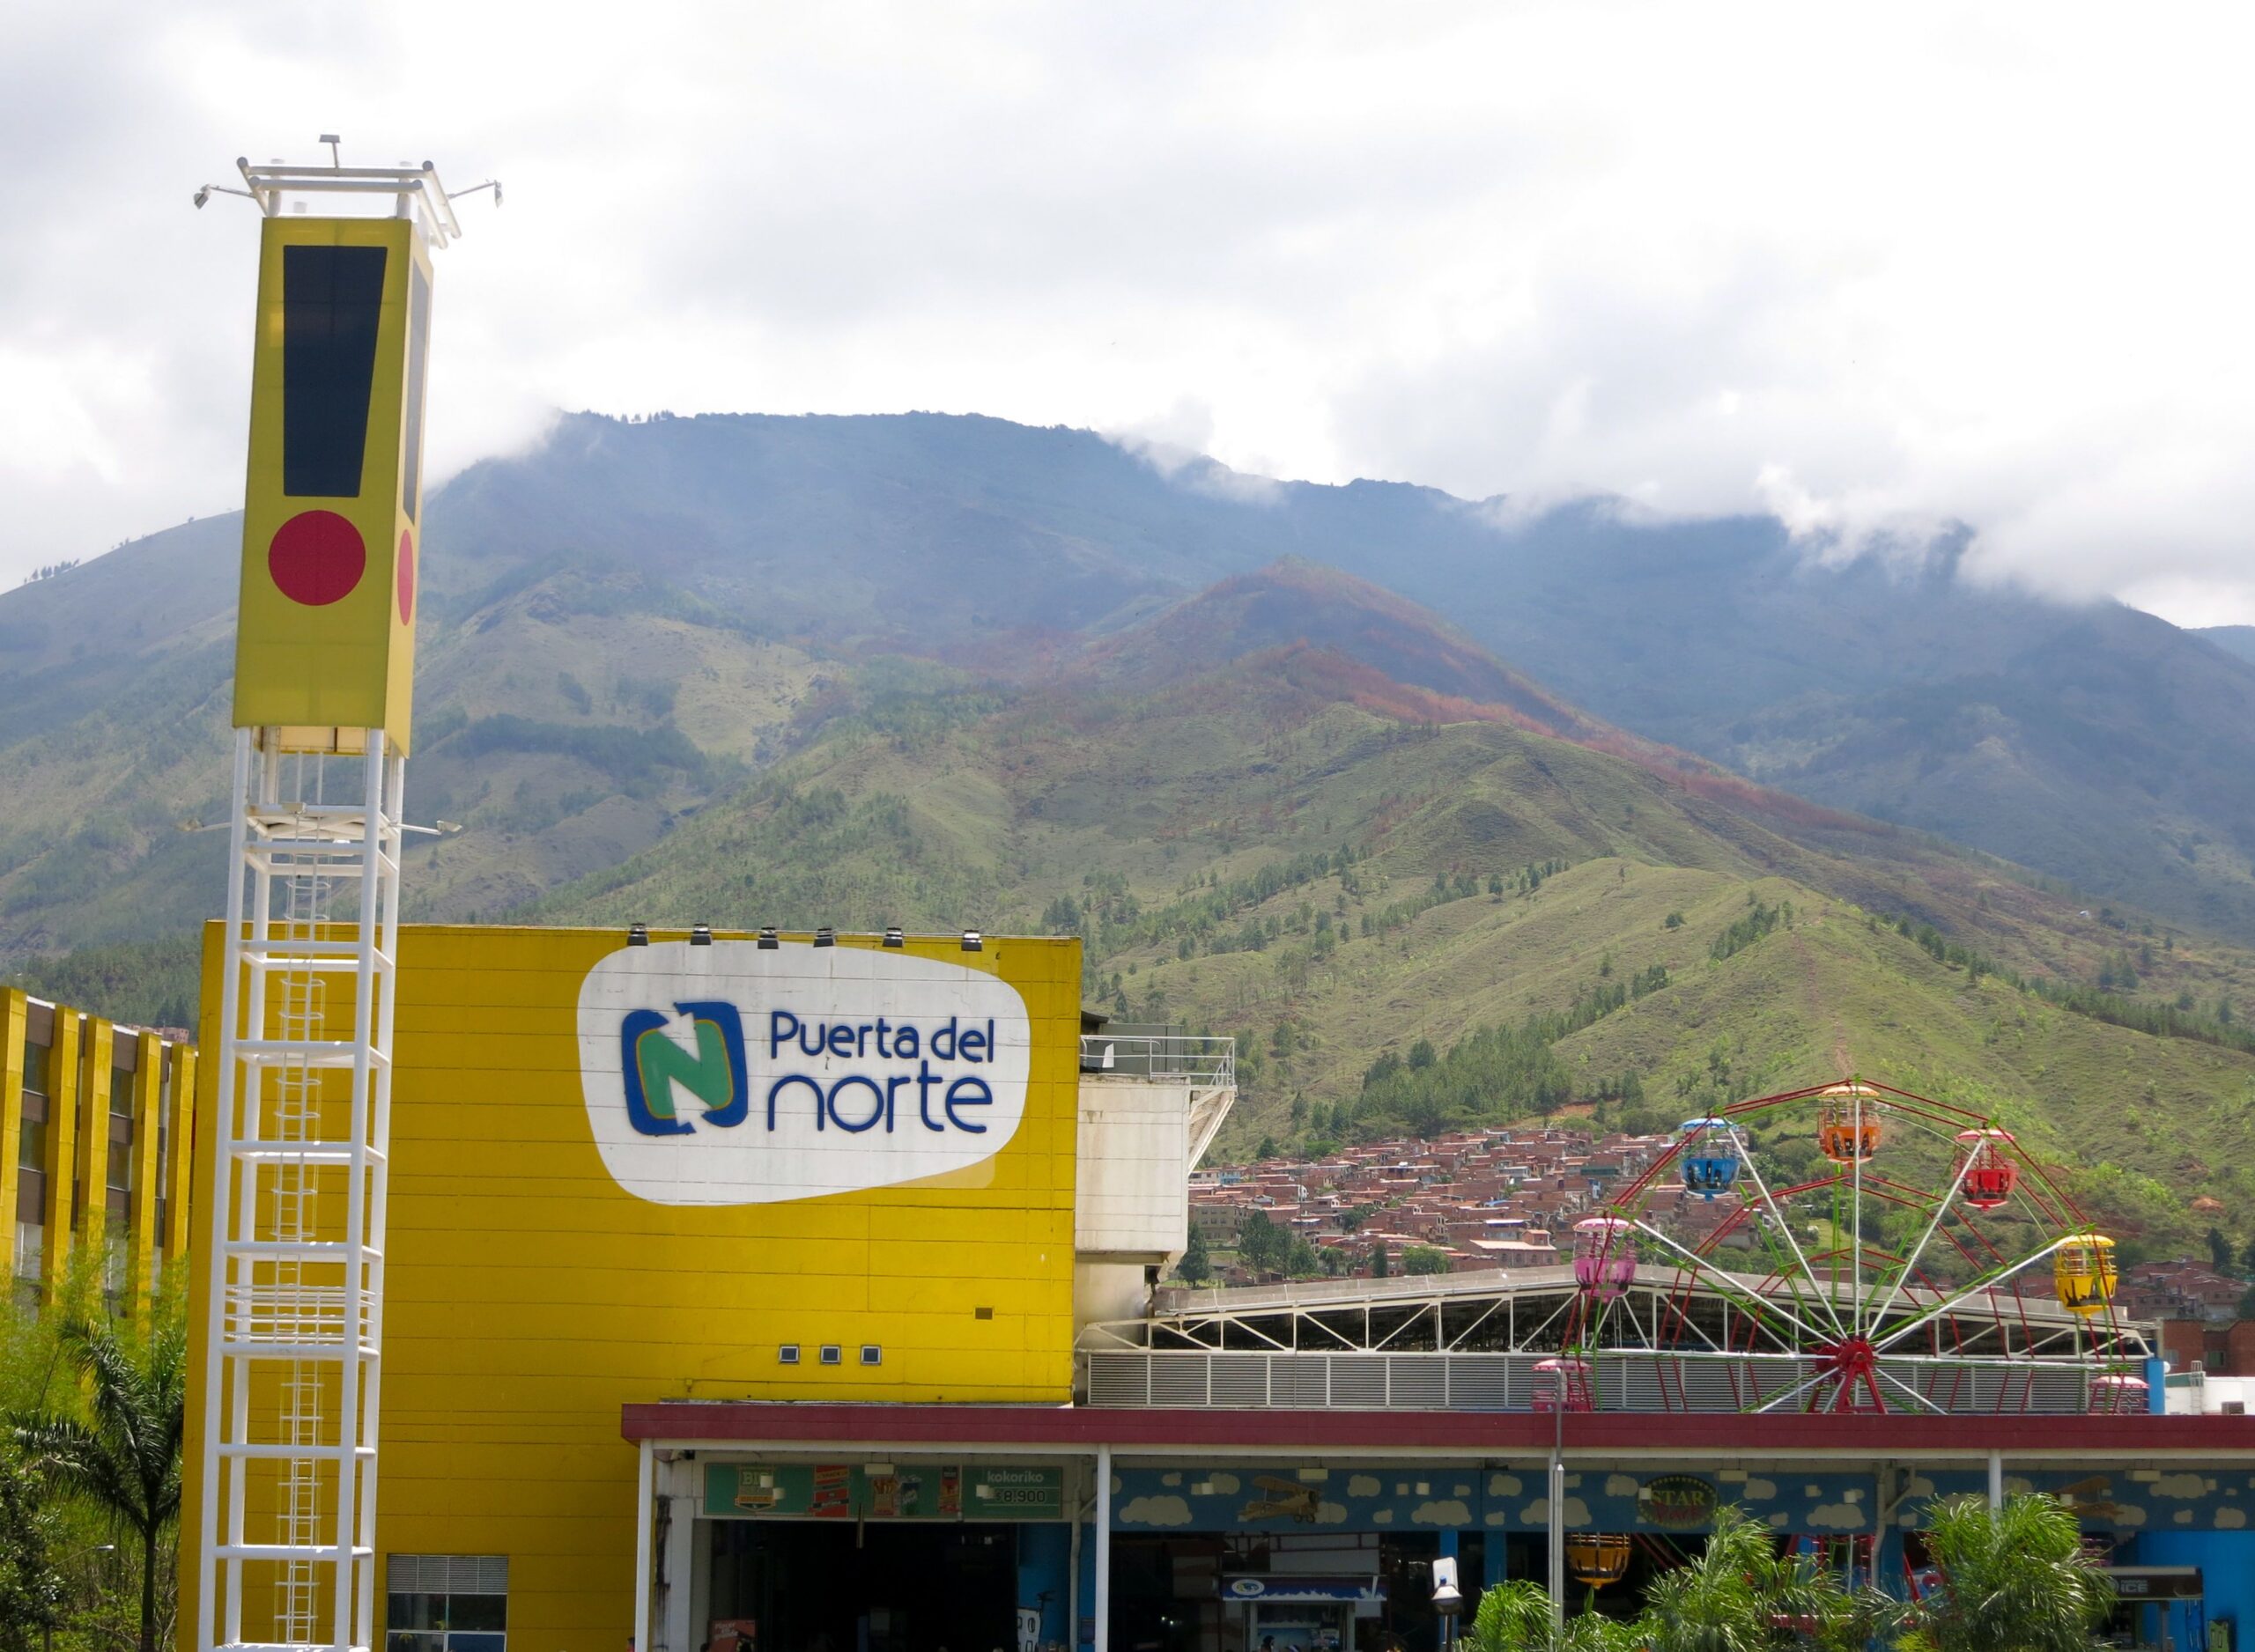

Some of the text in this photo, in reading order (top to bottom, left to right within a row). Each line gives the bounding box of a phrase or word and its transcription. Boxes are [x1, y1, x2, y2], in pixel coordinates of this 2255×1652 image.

[771, 1011, 994, 1063] Puerta del
[768, 1060, 993, 1133] norte
[743, 1471, 773, 1485] BI
[987, 1471, 1044, 1483] kokoriko
[1651, 1490, 1705, 1506] STAR
